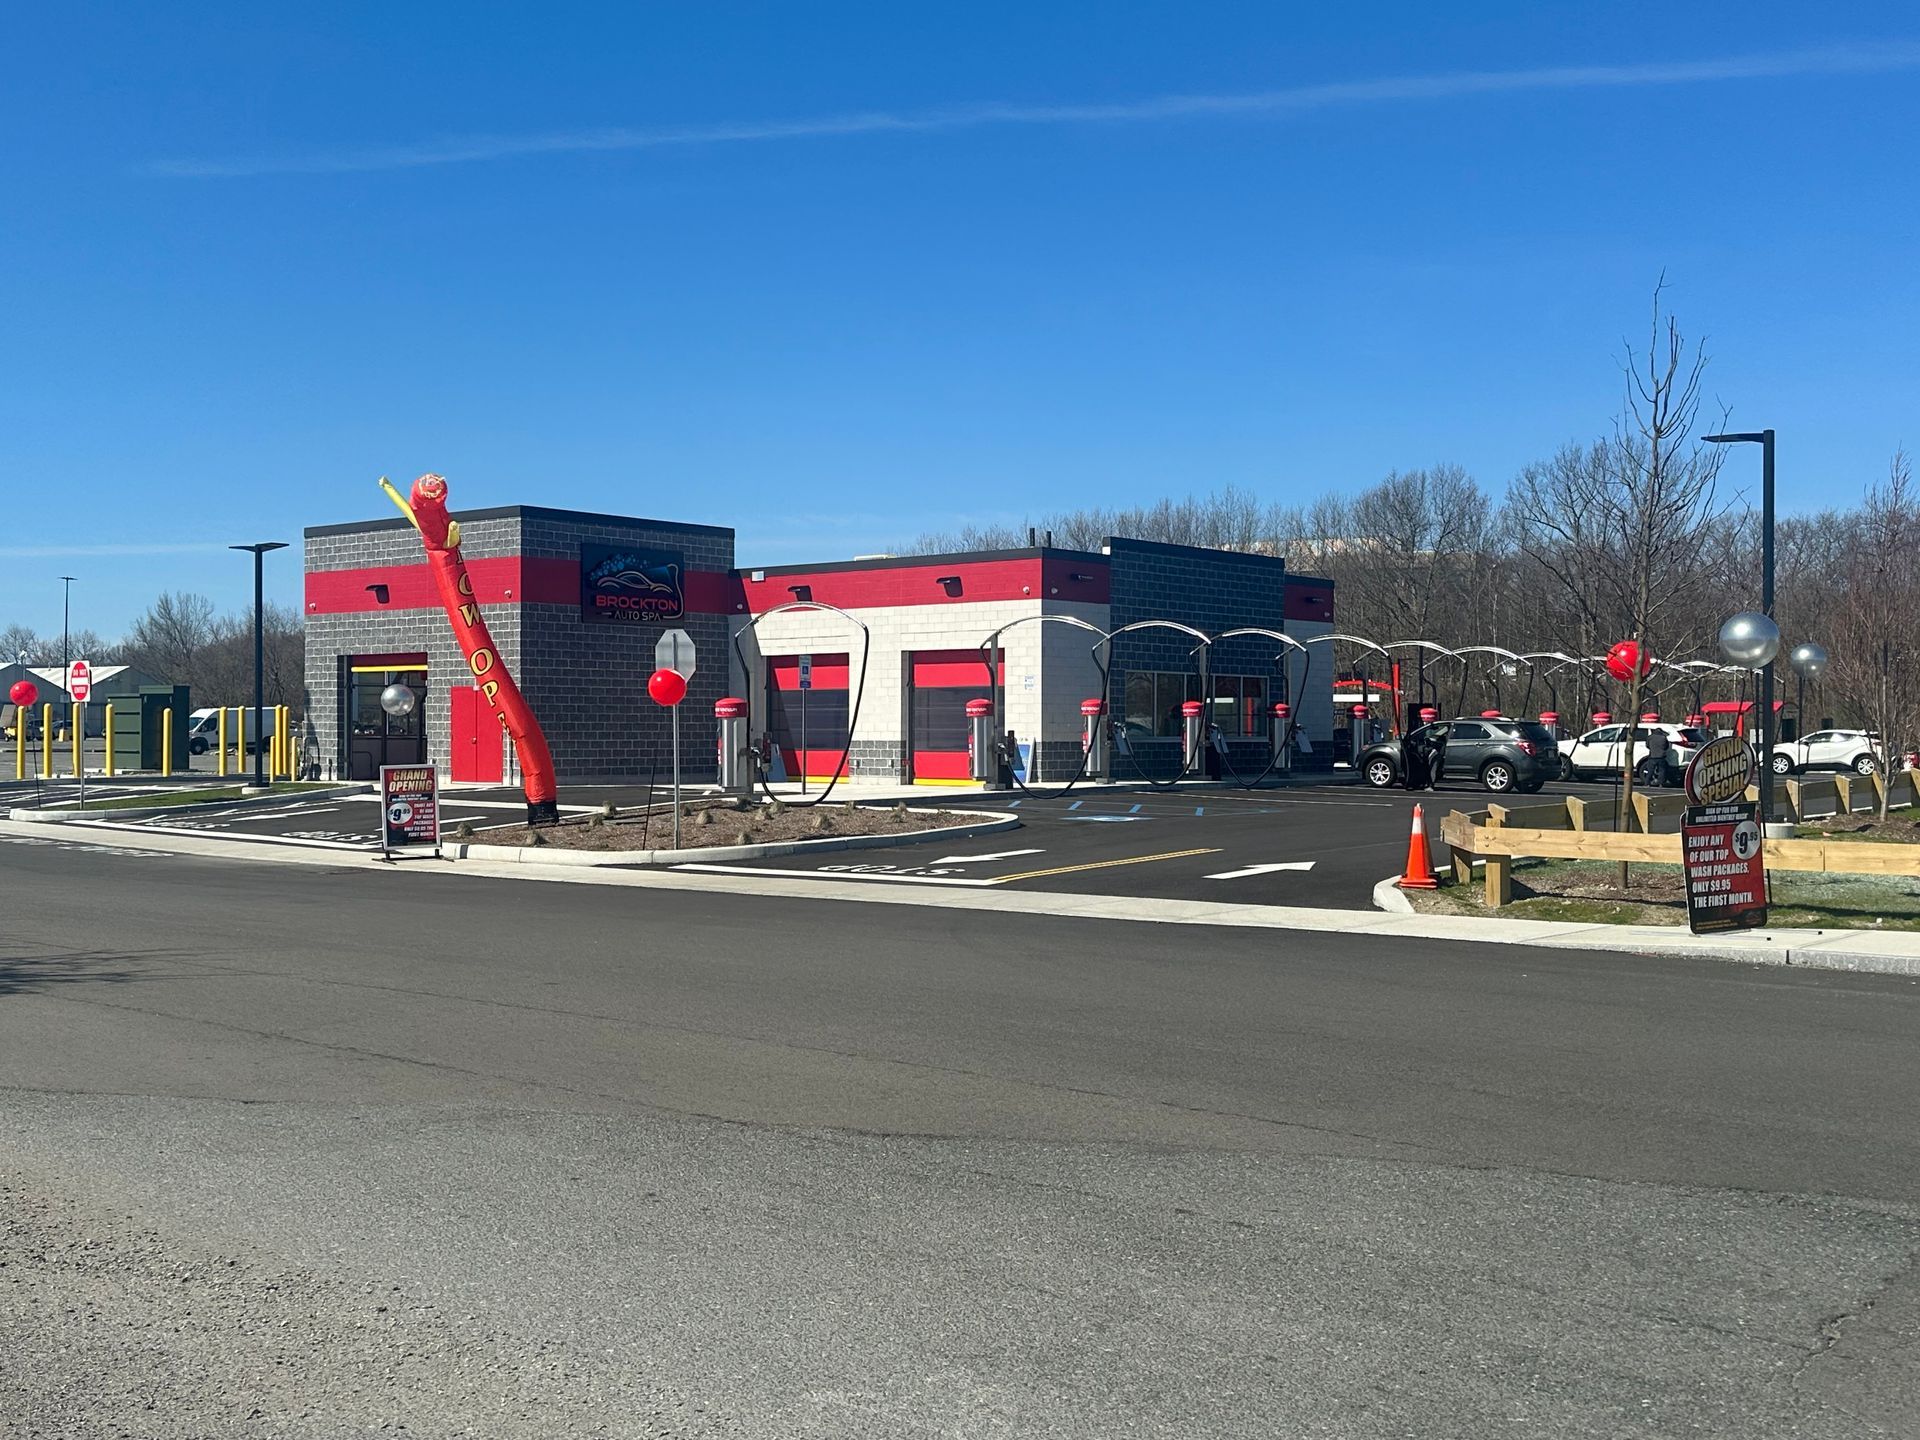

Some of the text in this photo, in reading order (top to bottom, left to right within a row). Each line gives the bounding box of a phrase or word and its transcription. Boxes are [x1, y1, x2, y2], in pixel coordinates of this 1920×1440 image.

[456, 549, 482, 628] OW
[596, 595, 678, 611] BROCKTON
[614, 610, 661, 621] AUTO SPA
[1703, 737, 1743, 767] GRAND
[393, 769, 427, 781] GRAND
[1699, 753, 1747, 788] OPENING
[388, 780, 433, 792] OPENING
[1701, 772, 1745, 806] SPECIAL
[1688, 834, 1724, 848] ENJOY ANY
[1689, 849, 1729, 863] OF OUR TOP
[1690, 865, 1712, 878] WASH
[1692, 879, 1731, 893] ONLY $9.95
[1694, 896, 1708, 909] THE
[1708, 894, 1728, 907] FIRST
